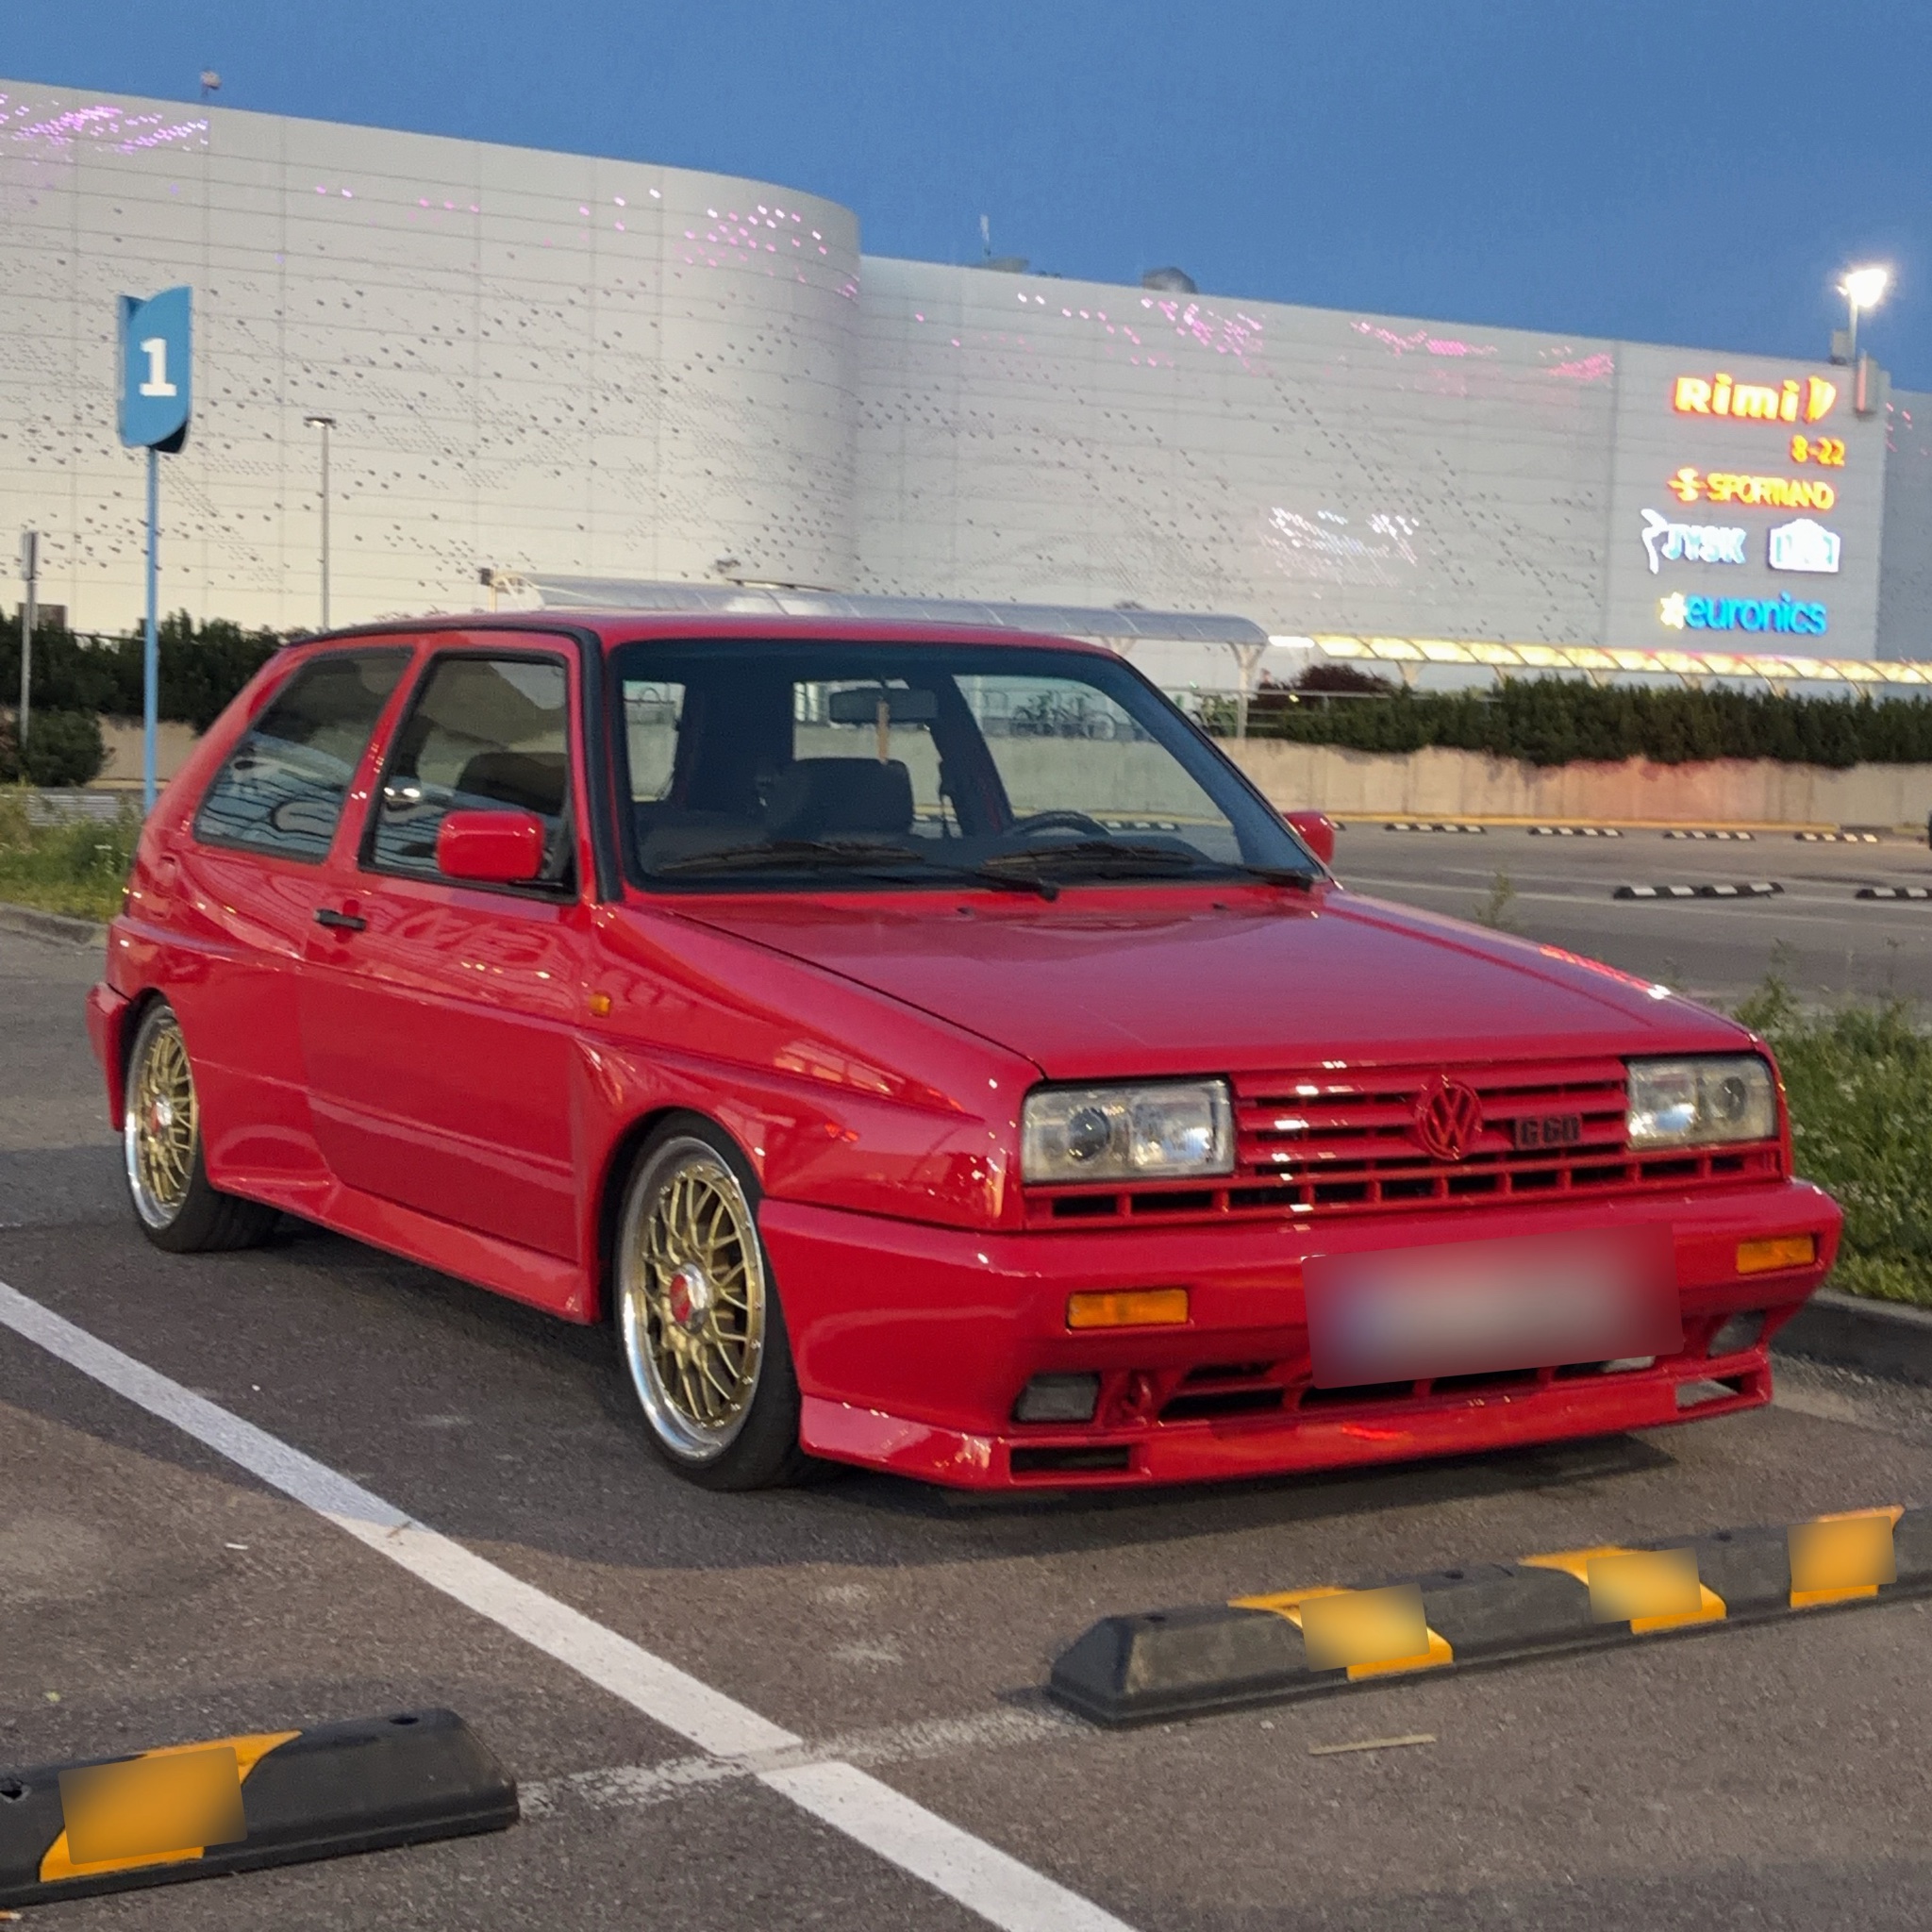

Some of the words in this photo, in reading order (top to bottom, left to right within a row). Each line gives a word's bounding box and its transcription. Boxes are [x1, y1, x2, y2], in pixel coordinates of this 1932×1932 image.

[140, 338, 177, 396] 1
[1674, 374, 1800, 422] Rimi
[1791, 435, 1845, 466] 8-22
[1685, 591, 1827, 634] euronics
